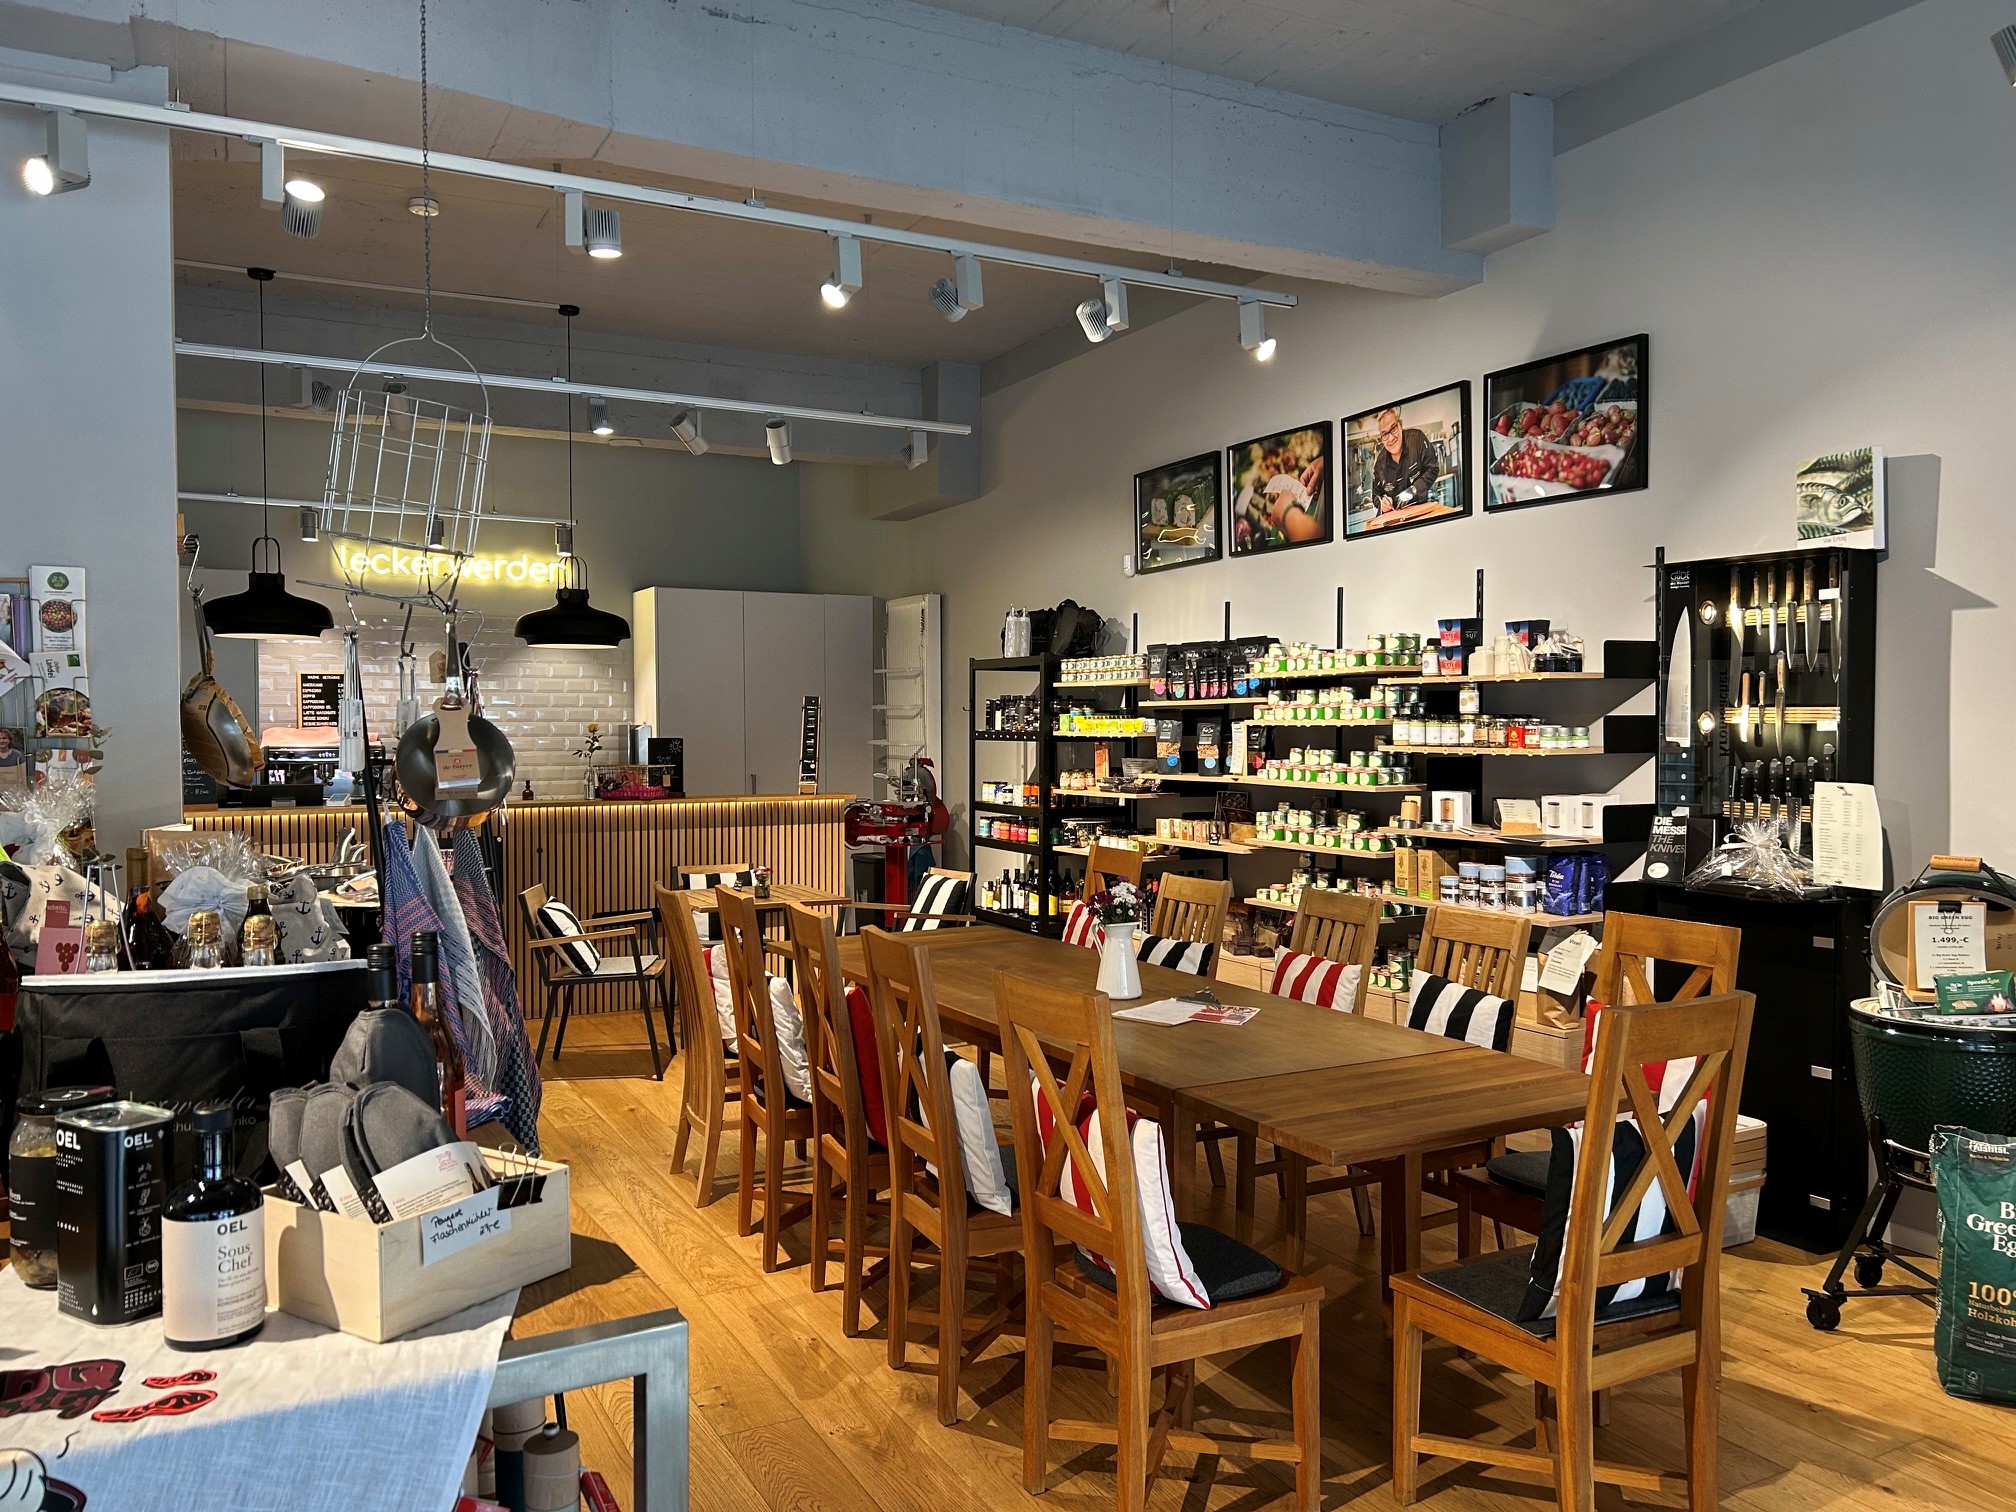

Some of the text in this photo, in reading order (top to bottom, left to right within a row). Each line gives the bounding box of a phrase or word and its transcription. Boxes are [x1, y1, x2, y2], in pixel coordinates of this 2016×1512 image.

[1654, 816, 1673, 826] DIE
[1649, 843, 1685, 853] KNIVES
[1653, 835, 1675, 844] THE
[56, 1129, 82, 1150] OEL
[123, 1132, 153, 1148] OEL
[1999, 1201, 2016, 1220] B
[217, 1219, 248, 1236] OEL
[218, 1243, 251, 1260] Sous
[218, 1252, 254, 1274] Chef
[1968, 1281, 2016, 1306] 100
